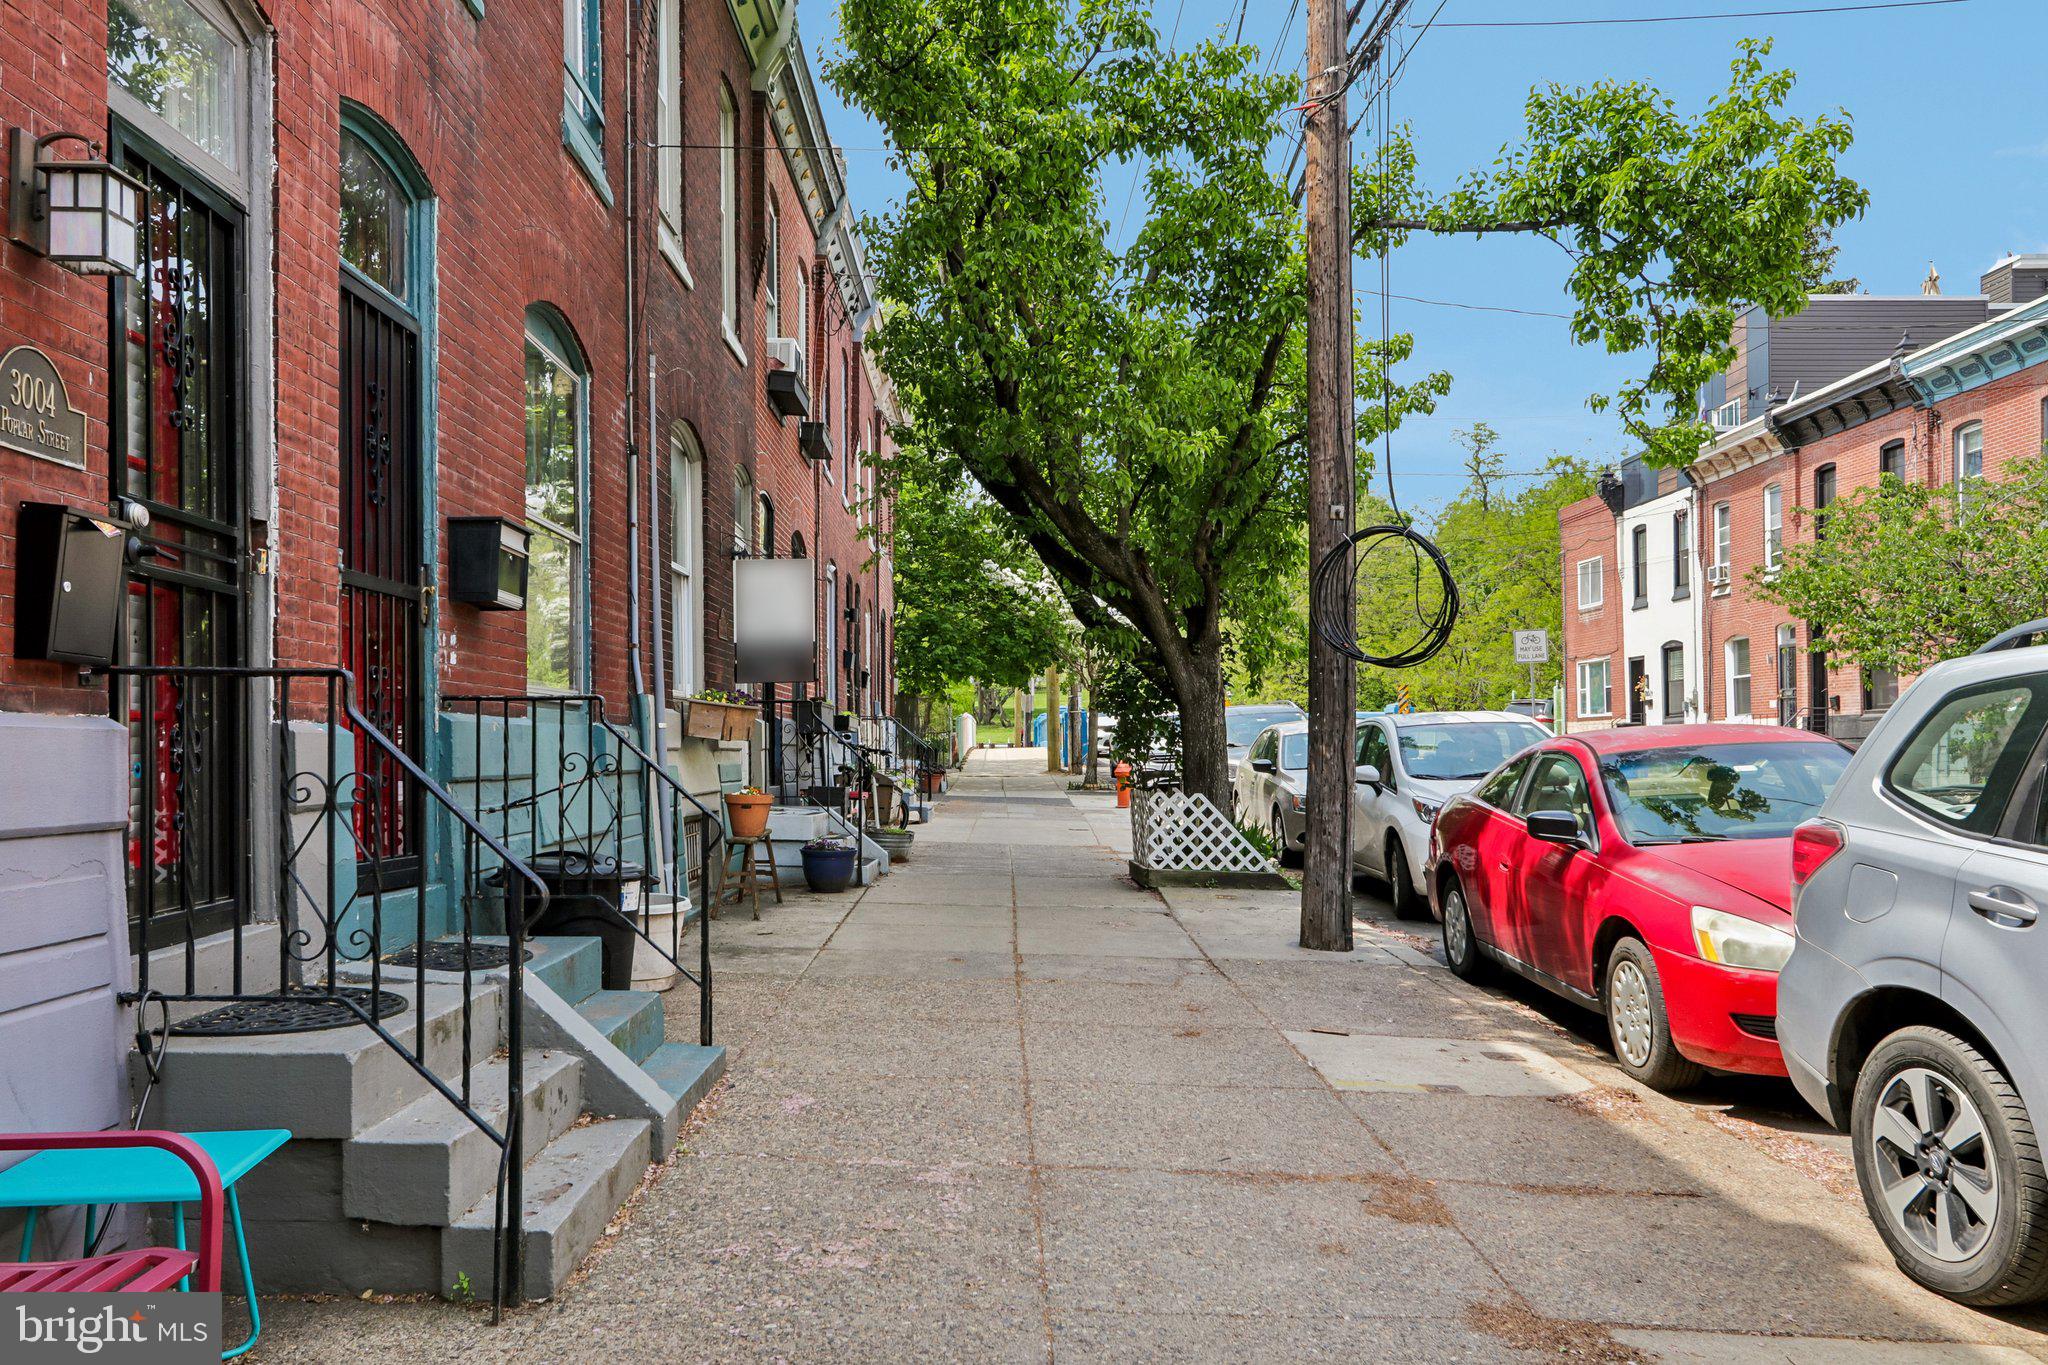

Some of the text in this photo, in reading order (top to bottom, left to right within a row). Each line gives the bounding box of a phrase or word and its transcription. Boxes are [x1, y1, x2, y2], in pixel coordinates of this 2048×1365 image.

[10, 368, 56, 418] 3004
[0, 405, 71, 452] POPLAR STREET
